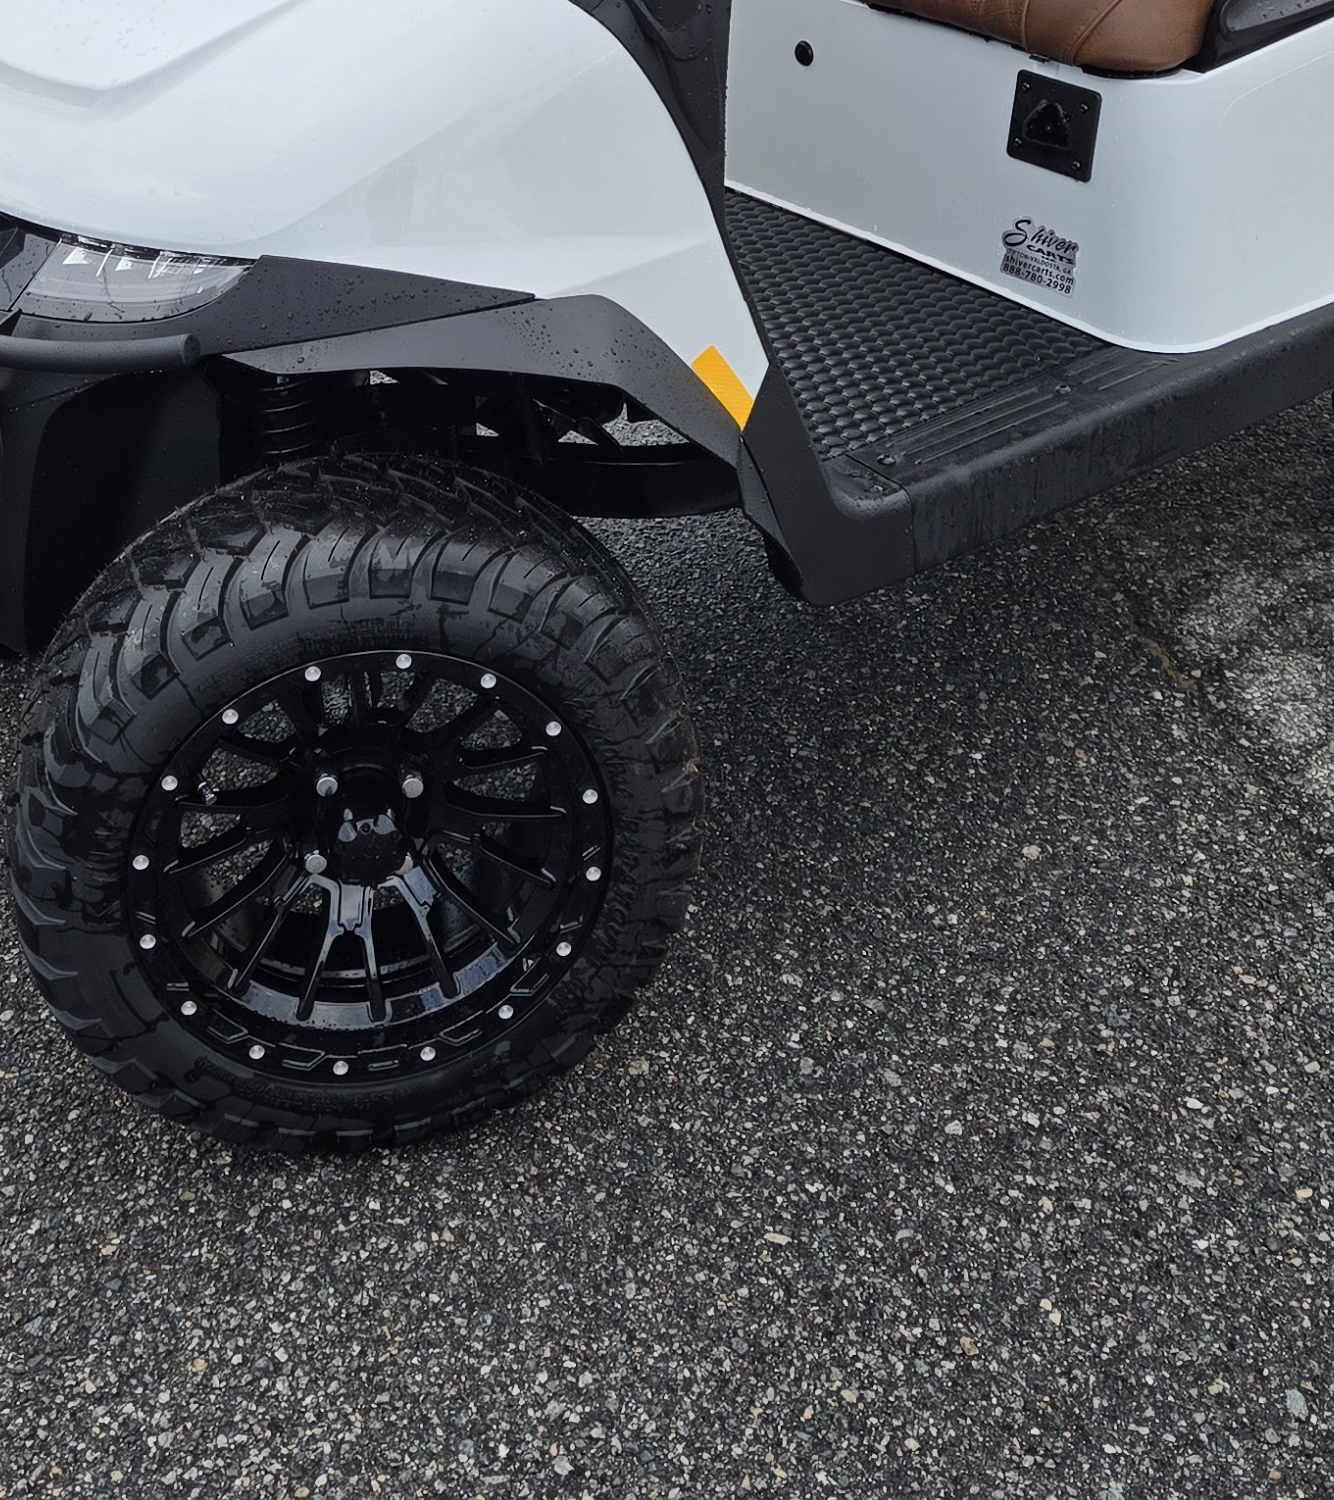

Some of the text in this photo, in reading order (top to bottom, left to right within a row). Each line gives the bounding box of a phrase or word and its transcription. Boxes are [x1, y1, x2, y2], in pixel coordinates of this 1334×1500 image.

[1004, 219, 1078, 253] Shiver
[1005, 254, 1074, 285] shivercarts.com
[1026, 244, 1075, 265] CARTS
[1002, 263, 1072, 294] 888-780-2998
